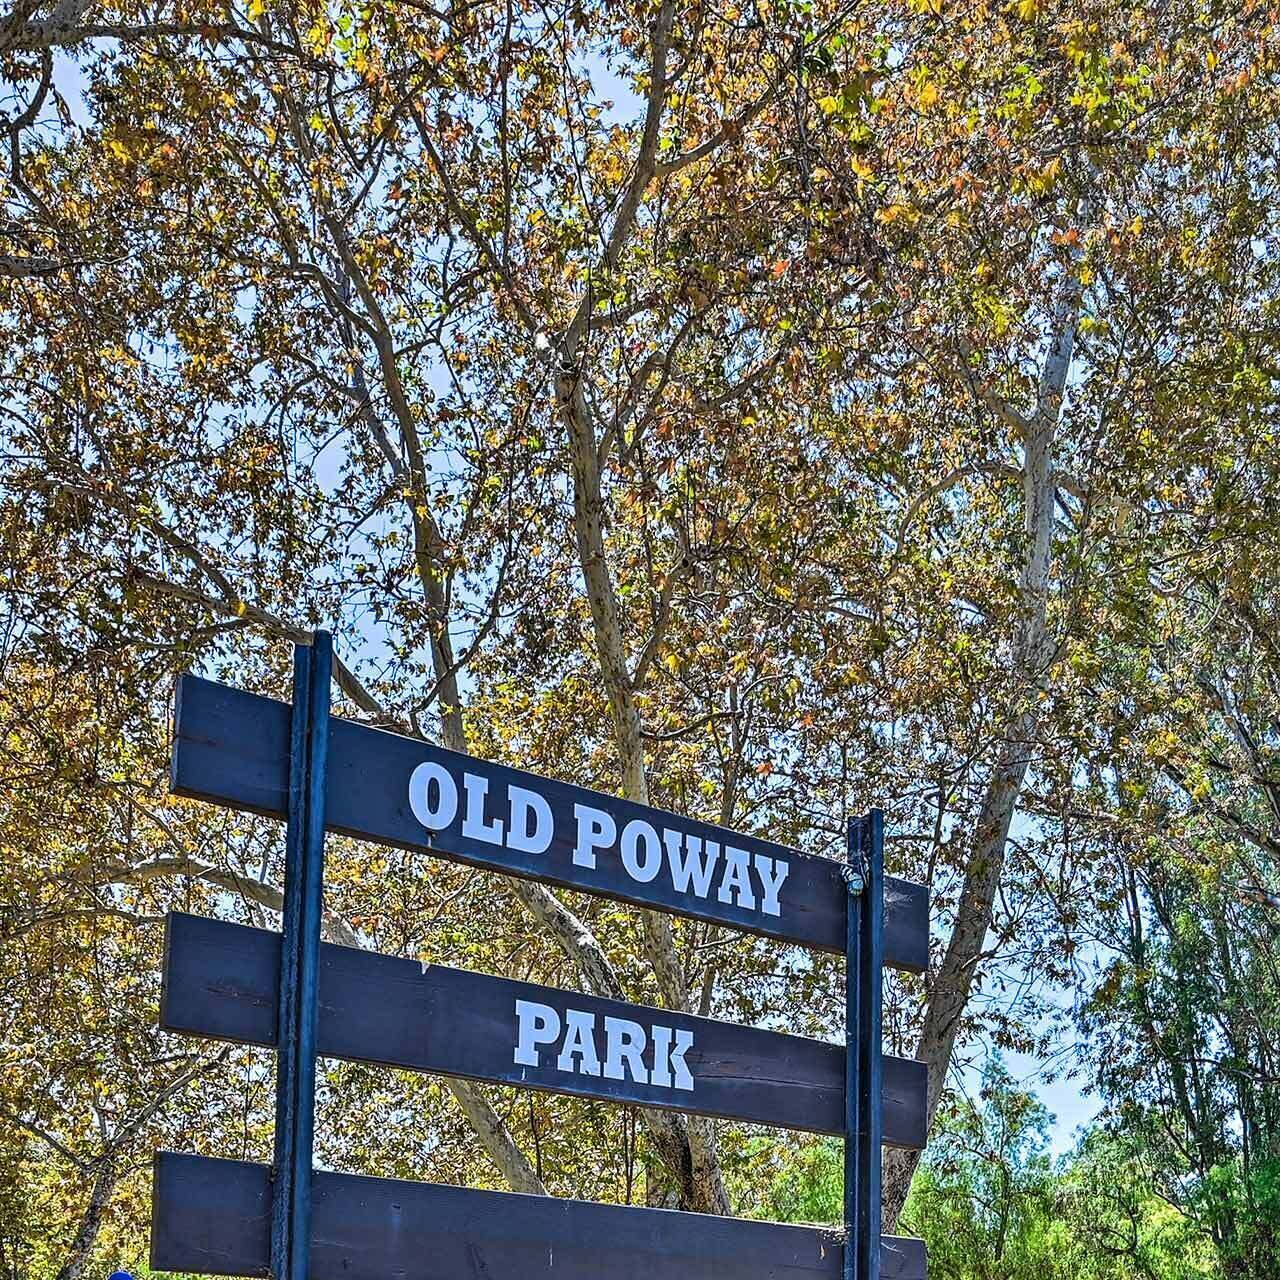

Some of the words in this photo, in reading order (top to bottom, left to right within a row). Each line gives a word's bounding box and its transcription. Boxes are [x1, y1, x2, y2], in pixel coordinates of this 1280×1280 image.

[408, 761, 554, 855] OLD
[572, 803, 790, 917] POWAY
[514, 999, 694, 1092] PARK
